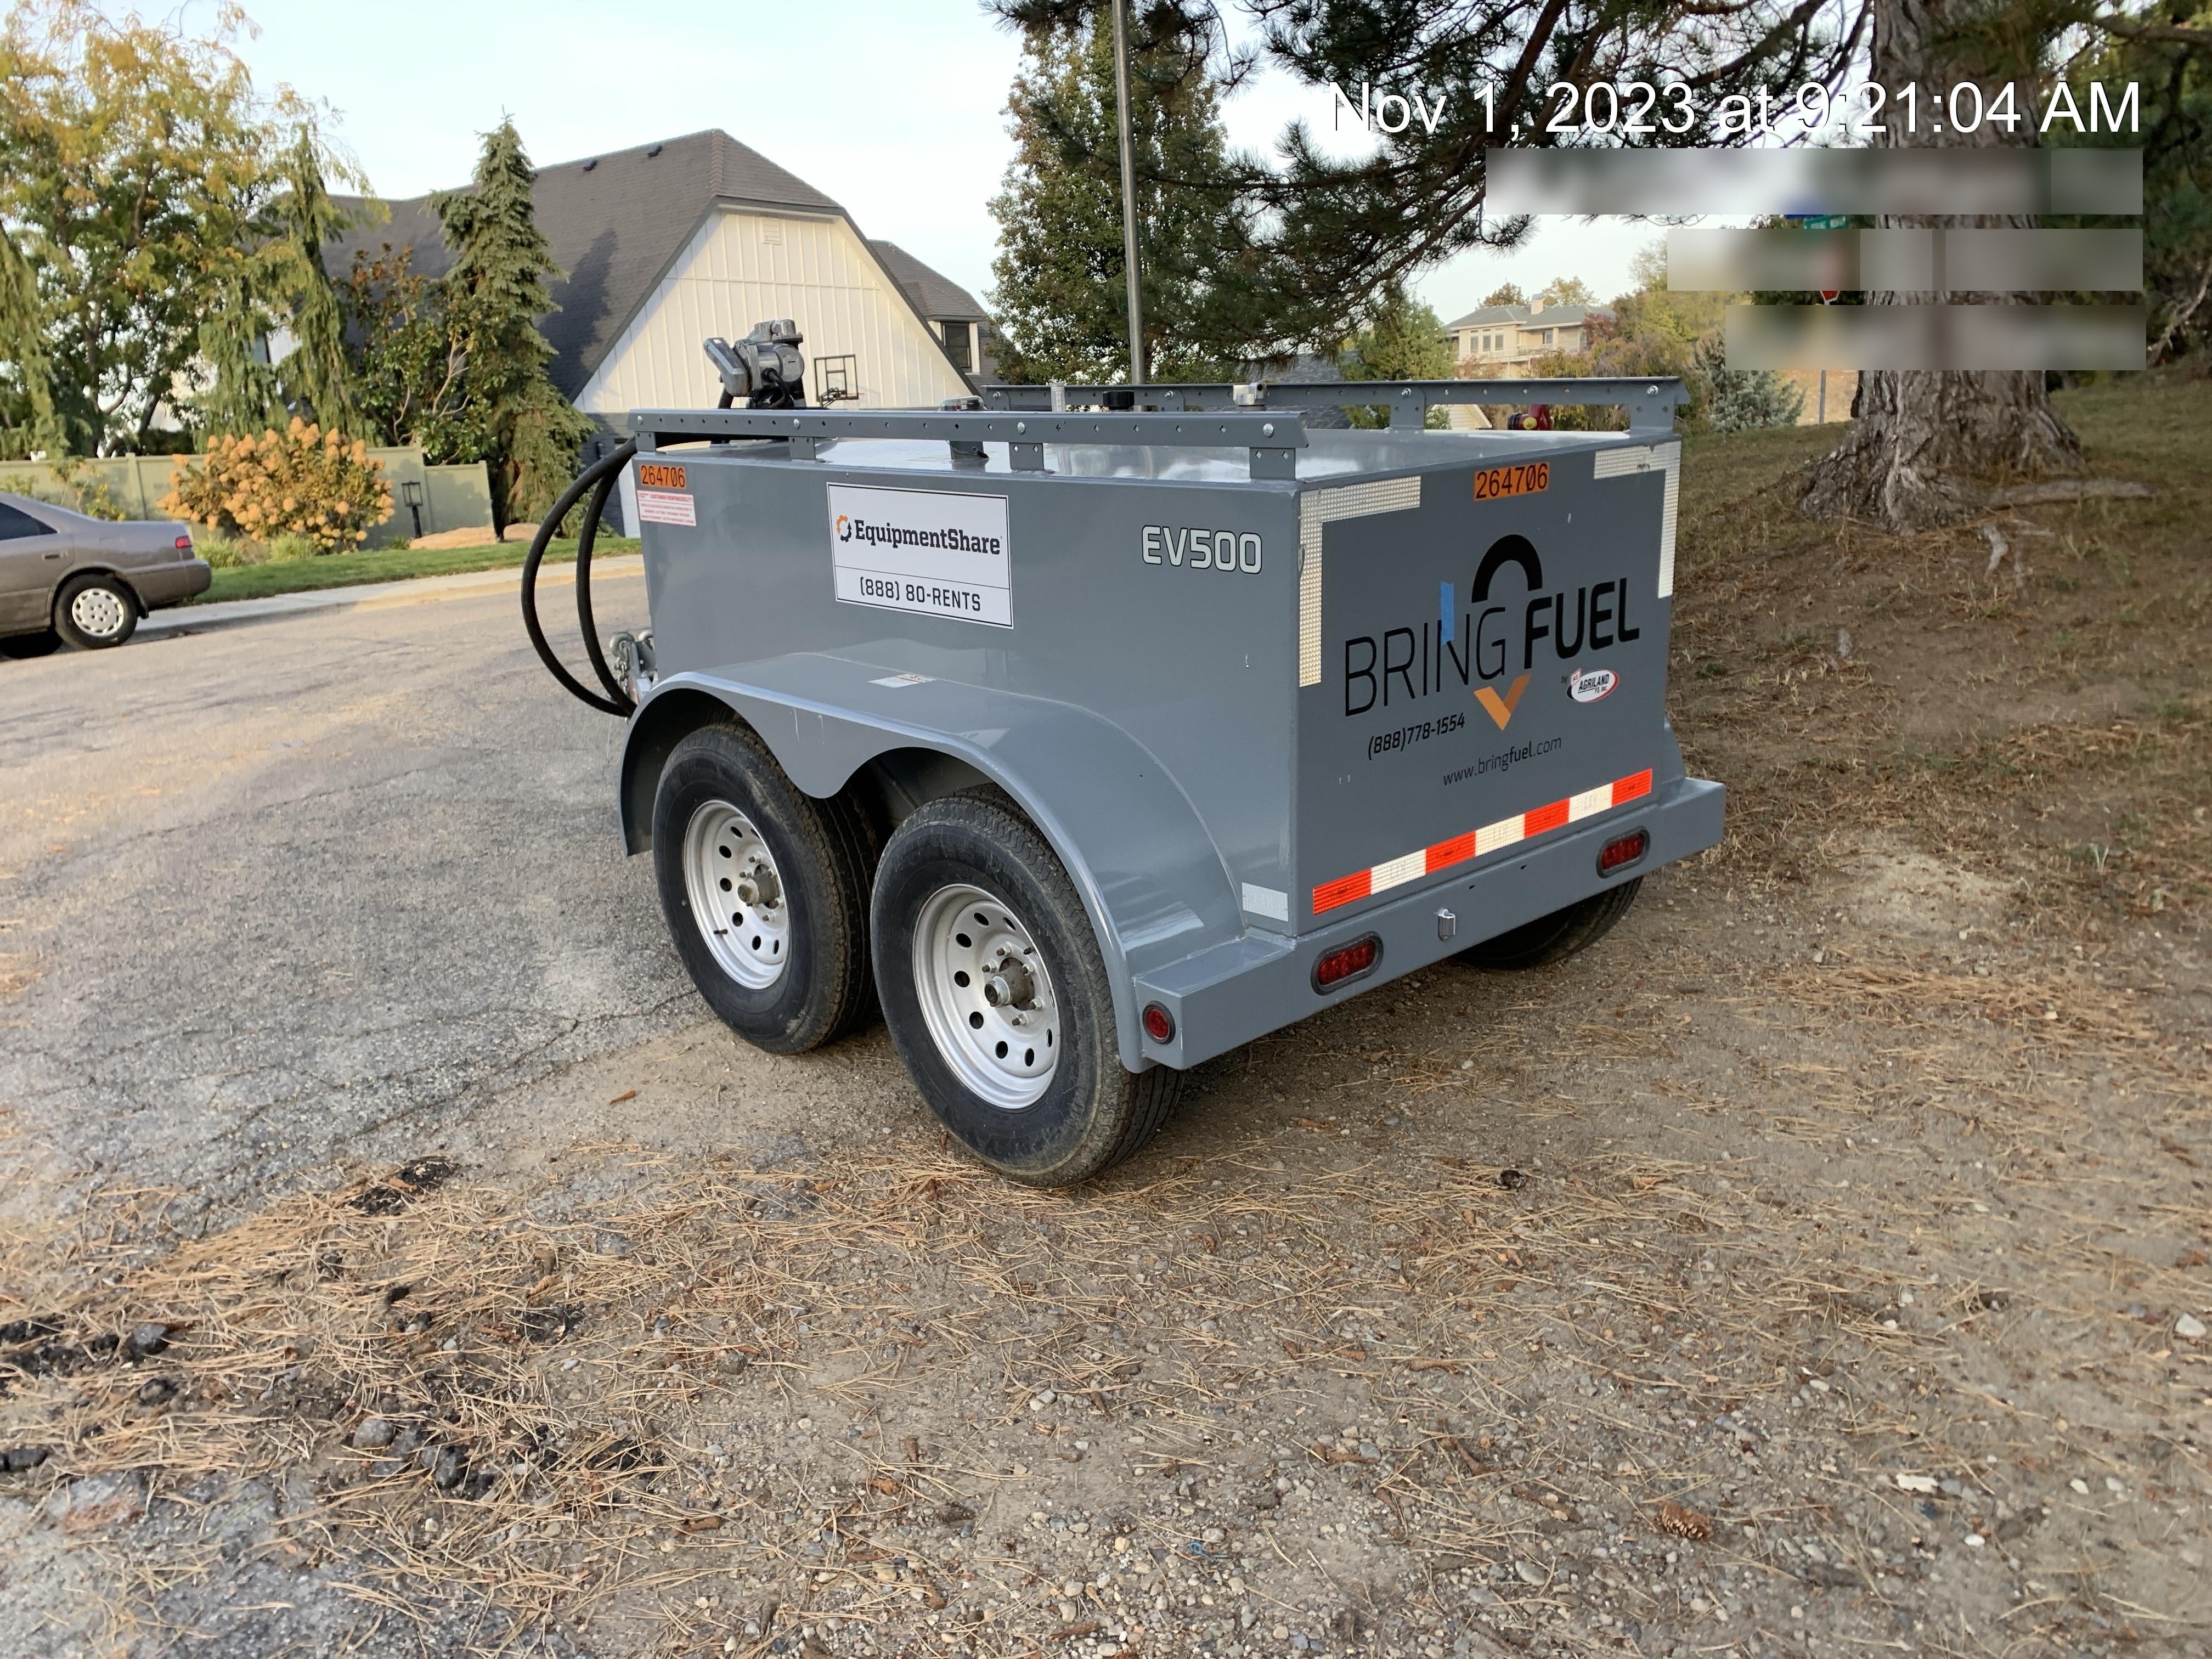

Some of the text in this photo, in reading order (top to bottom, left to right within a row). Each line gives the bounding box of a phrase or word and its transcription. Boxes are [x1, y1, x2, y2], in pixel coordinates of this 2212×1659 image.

[641, 465, 685, 487] 264706
[1476, 462, 1548, 498] 264706
[855, 519, 1001, 555] EquipmentShare
[1141, 525, 1263, 574] EV500
[860, 576, 981, 612] (888) 80-RENTS
[1345, 577, 1641, 717] BRING FUEL
[1579, 674, 1610, 691] AGRILAND
[1368, 713, 1465, 760] (888)778-1554
[1442, 736, 1562, 786] www.bringfuel.com
